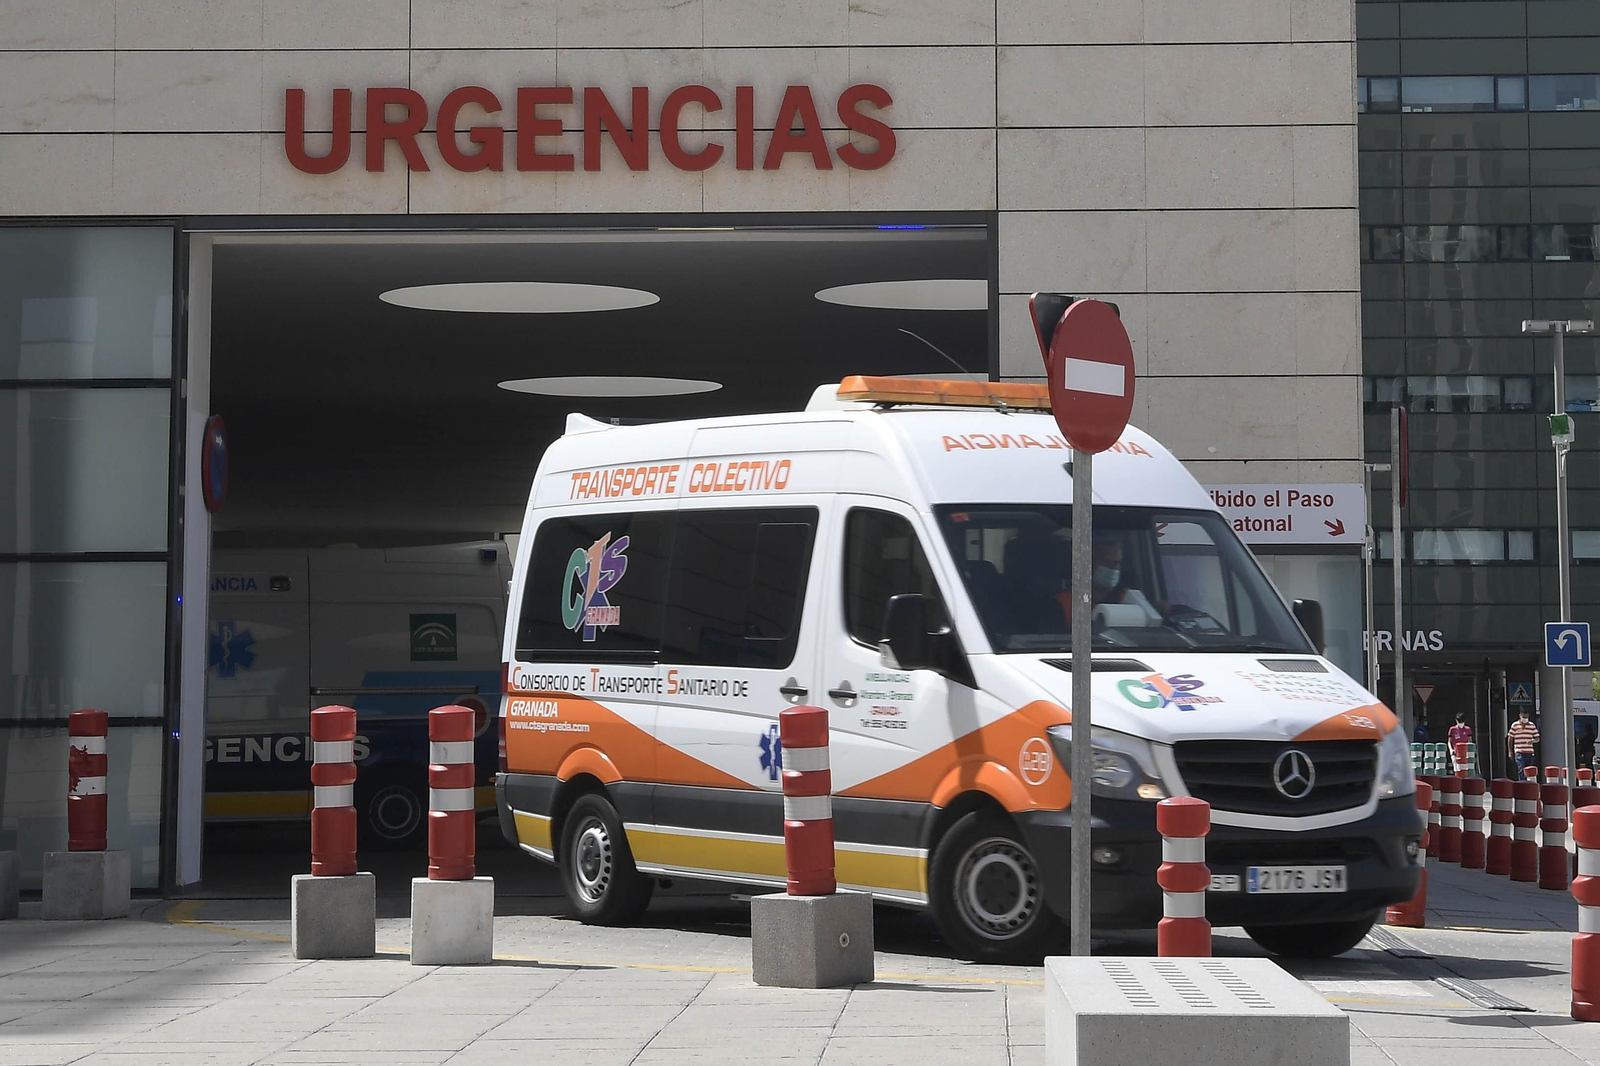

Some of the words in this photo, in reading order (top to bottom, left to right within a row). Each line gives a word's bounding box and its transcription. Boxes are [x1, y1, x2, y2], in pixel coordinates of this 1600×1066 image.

[285, 85, 897, 174] URGENCIAS
[570, 464, 681, 500] TRANSPORTE
[689, 459, 792, 493] COLECTIVO
[1210, 490, 1256, 507] ibido
[1263, 490, 1280, 507] el
[1287, 490, 1334, 507] Paso
[1228, 515, 1292, 531] atonal
[211, 577, 258, 591] NCIA
[562, 531, 630, 629] CTS
[586, 606, 620, 625] GRANADA
[1363, 630, 1444, 651] ERNAS
[512, 666, 570, 691] CONSORCIO
[572, 675, 586, 691] DE
[591, 668, 662, 694] TRANSPORTE
[667, 670, 729, 696] SANITARIO
[733, 680, 748, 697] DE
[1117, 673, 1204, 709] CTS
[510, 700, 558, 717] GRANADA
[510, 721, 590, 733] www.ctsgranada.com
[206, 735, 370, 762] ENCIS
[1259, 869, 1306, 890] 2176
